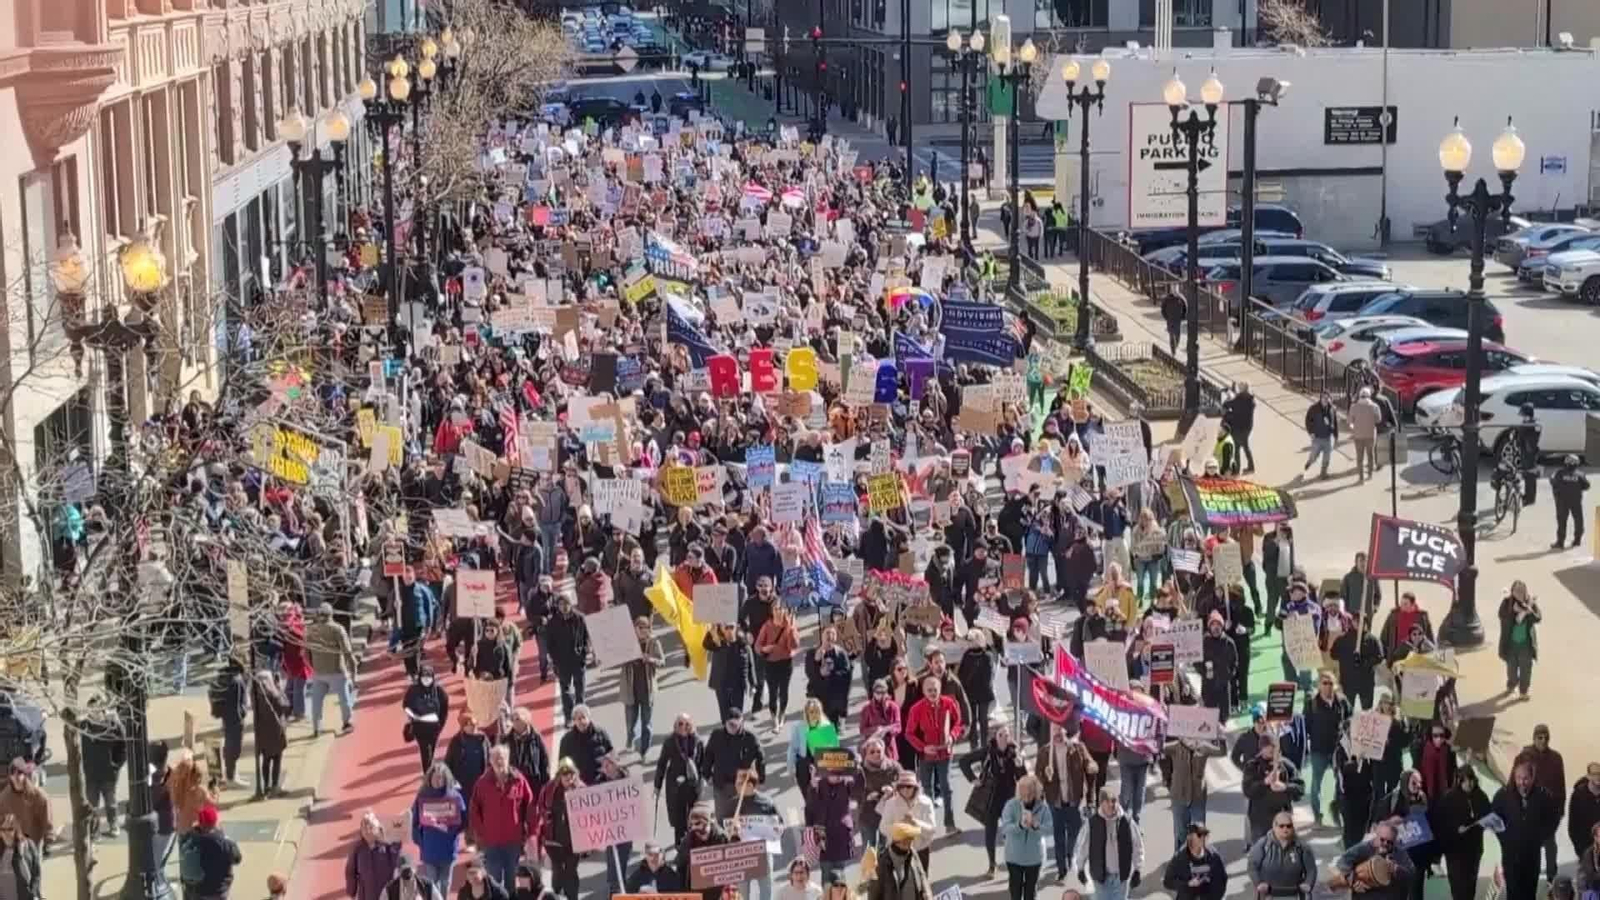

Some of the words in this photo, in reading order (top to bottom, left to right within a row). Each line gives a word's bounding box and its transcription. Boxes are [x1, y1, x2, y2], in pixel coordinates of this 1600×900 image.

[1140, 147, 1219, 159] PARKNG
[1398, 526, 1458, 559] FUCK
[1406, 550, 1446, 572] ICE
[569, 793, 601, 809] END
[607, 784, 640, 803] THIS
[577, 804, 636, 828] UNJUST
[587, 825, 627, 844] WAR
